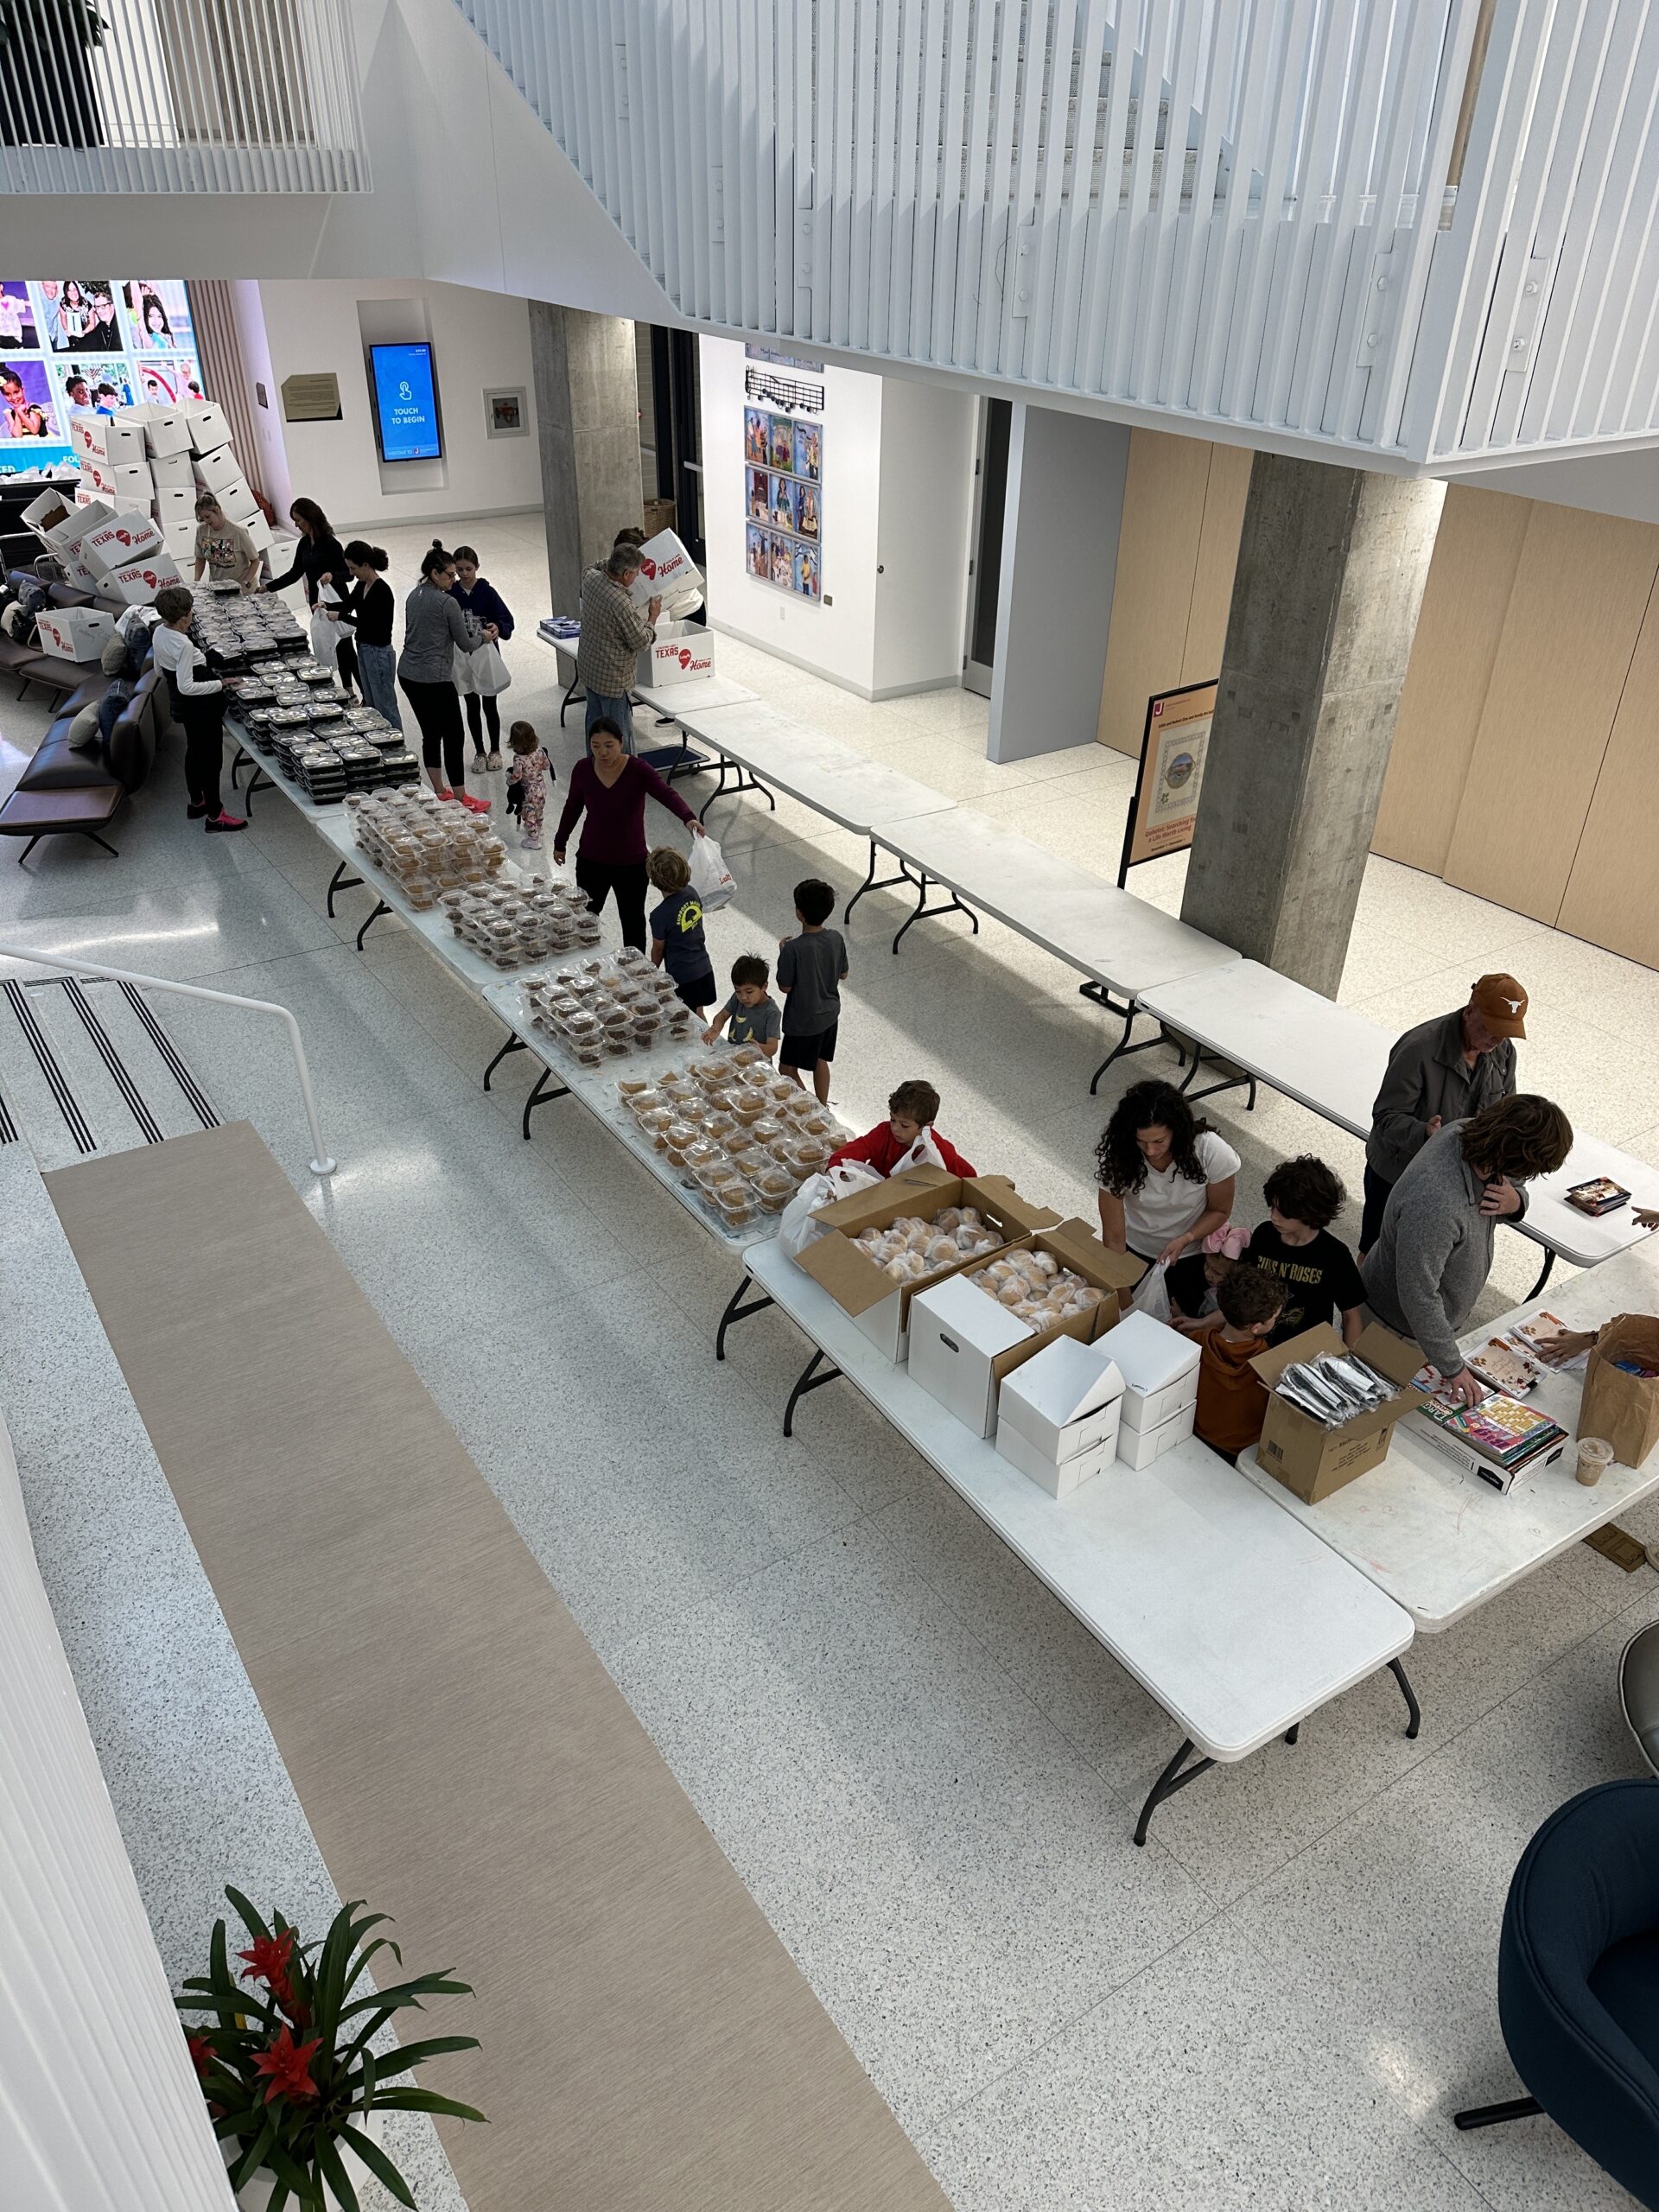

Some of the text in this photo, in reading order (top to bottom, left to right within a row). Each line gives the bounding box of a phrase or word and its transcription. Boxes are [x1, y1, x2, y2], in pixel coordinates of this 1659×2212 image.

[91, 531, 116, 547] TEXAS
[132, 530, 155, 545] Home
[658, 556, 684, 578] Home
[118, 570, 143, 584] TEXAS
[157, 577, 181, 588] Home
[655, 646, 678, 658] TEXAS
[690, 659, 712, 671] Home
[677, 901, 690, 925] SUPPORT
[1289, 1262, 1323, 1285] ROSES
